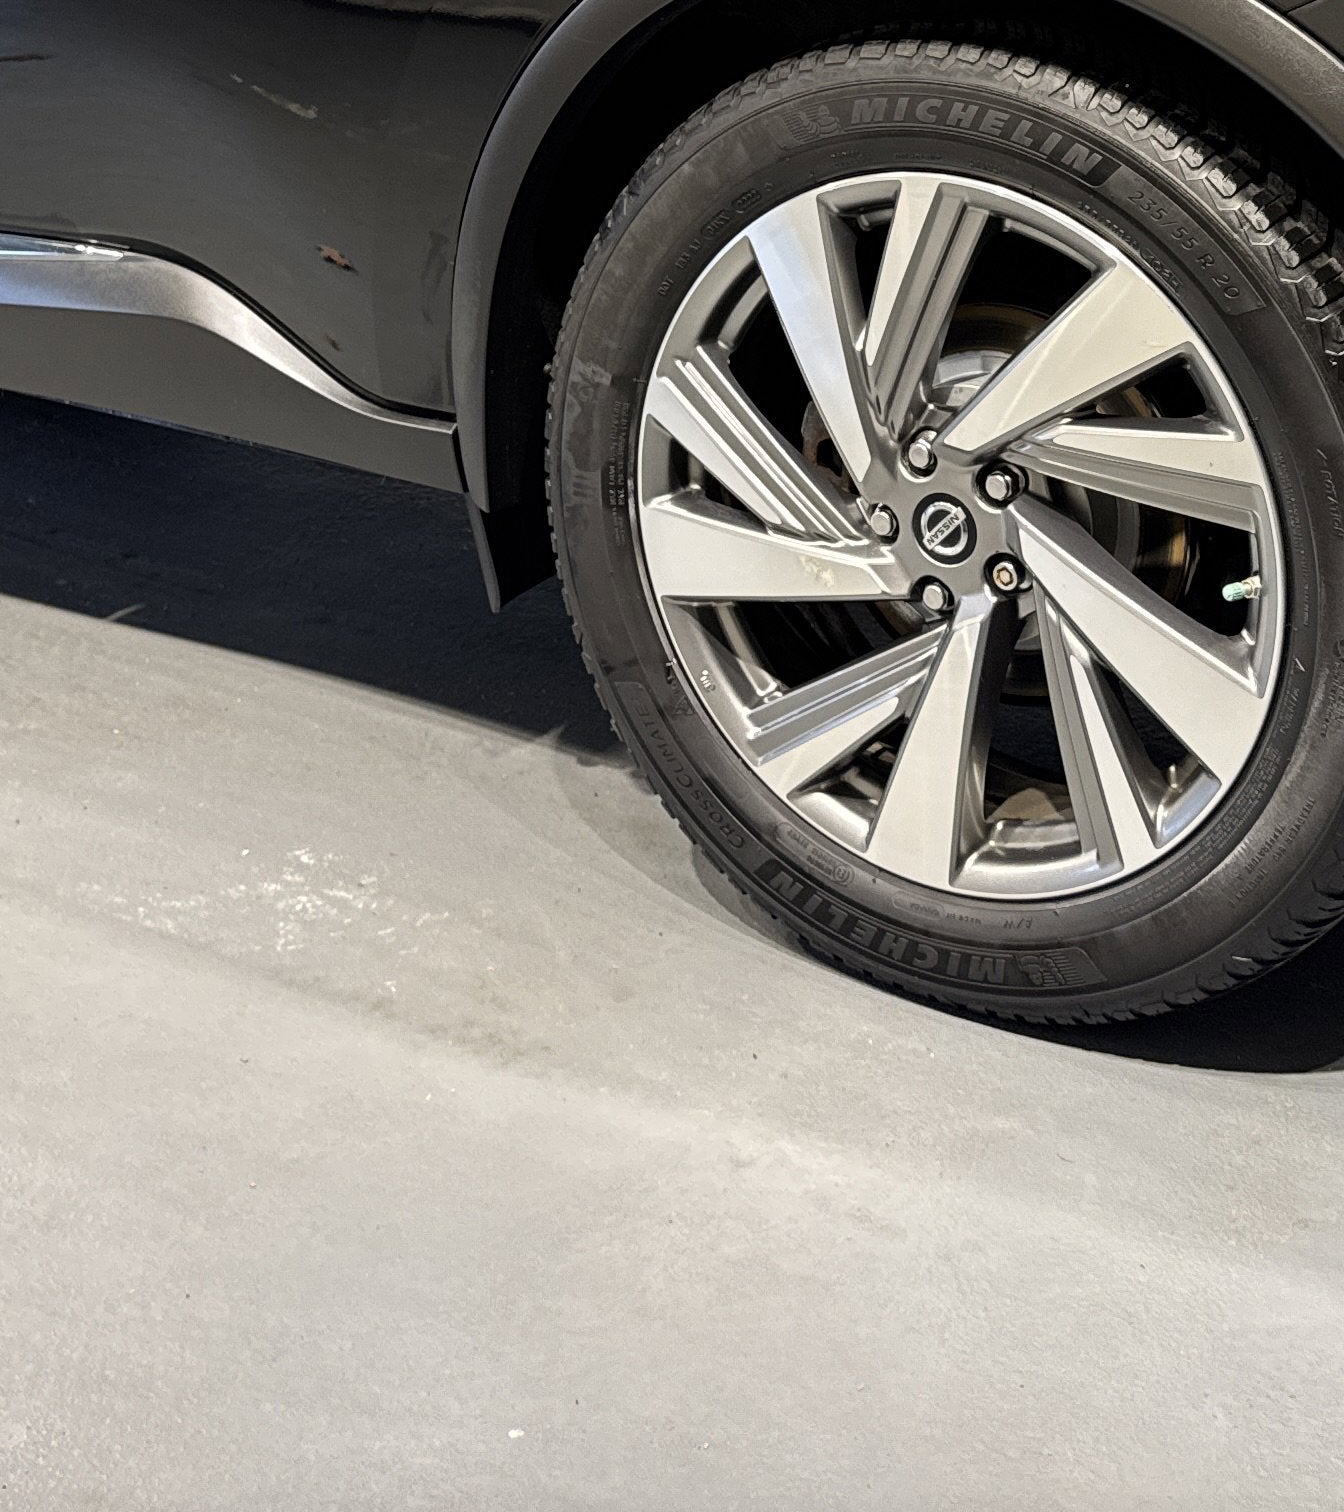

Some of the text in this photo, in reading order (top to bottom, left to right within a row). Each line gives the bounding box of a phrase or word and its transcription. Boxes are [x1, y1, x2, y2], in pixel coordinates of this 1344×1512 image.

[850, 96, 1105, 177] MICHELIN
[1126, 190, 1240, 299] 235/55 R 20
[926, 513, 960, 545] NISSAN
[765, 869, 1006, 984] MICHELIN
